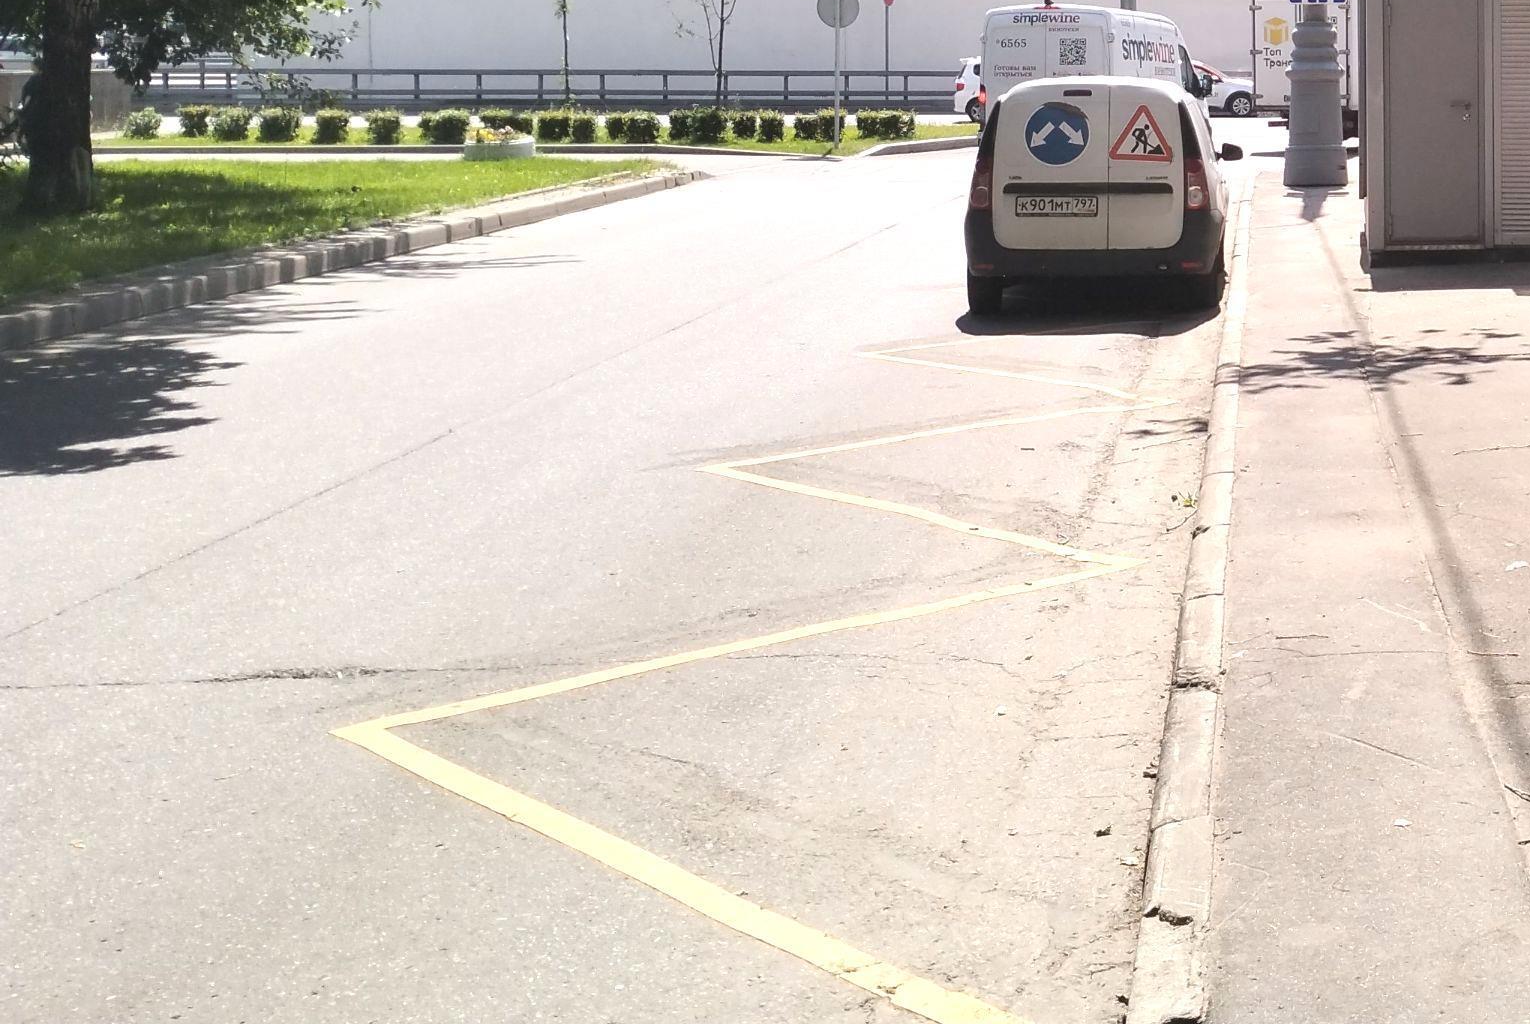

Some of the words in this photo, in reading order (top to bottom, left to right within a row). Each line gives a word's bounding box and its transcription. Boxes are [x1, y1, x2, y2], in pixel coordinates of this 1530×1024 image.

[1013, 12, 1080, 26] simplewine
[1122, 32, 1175, 68] simplewine
[1263, 47, 1281, 56] Топ
